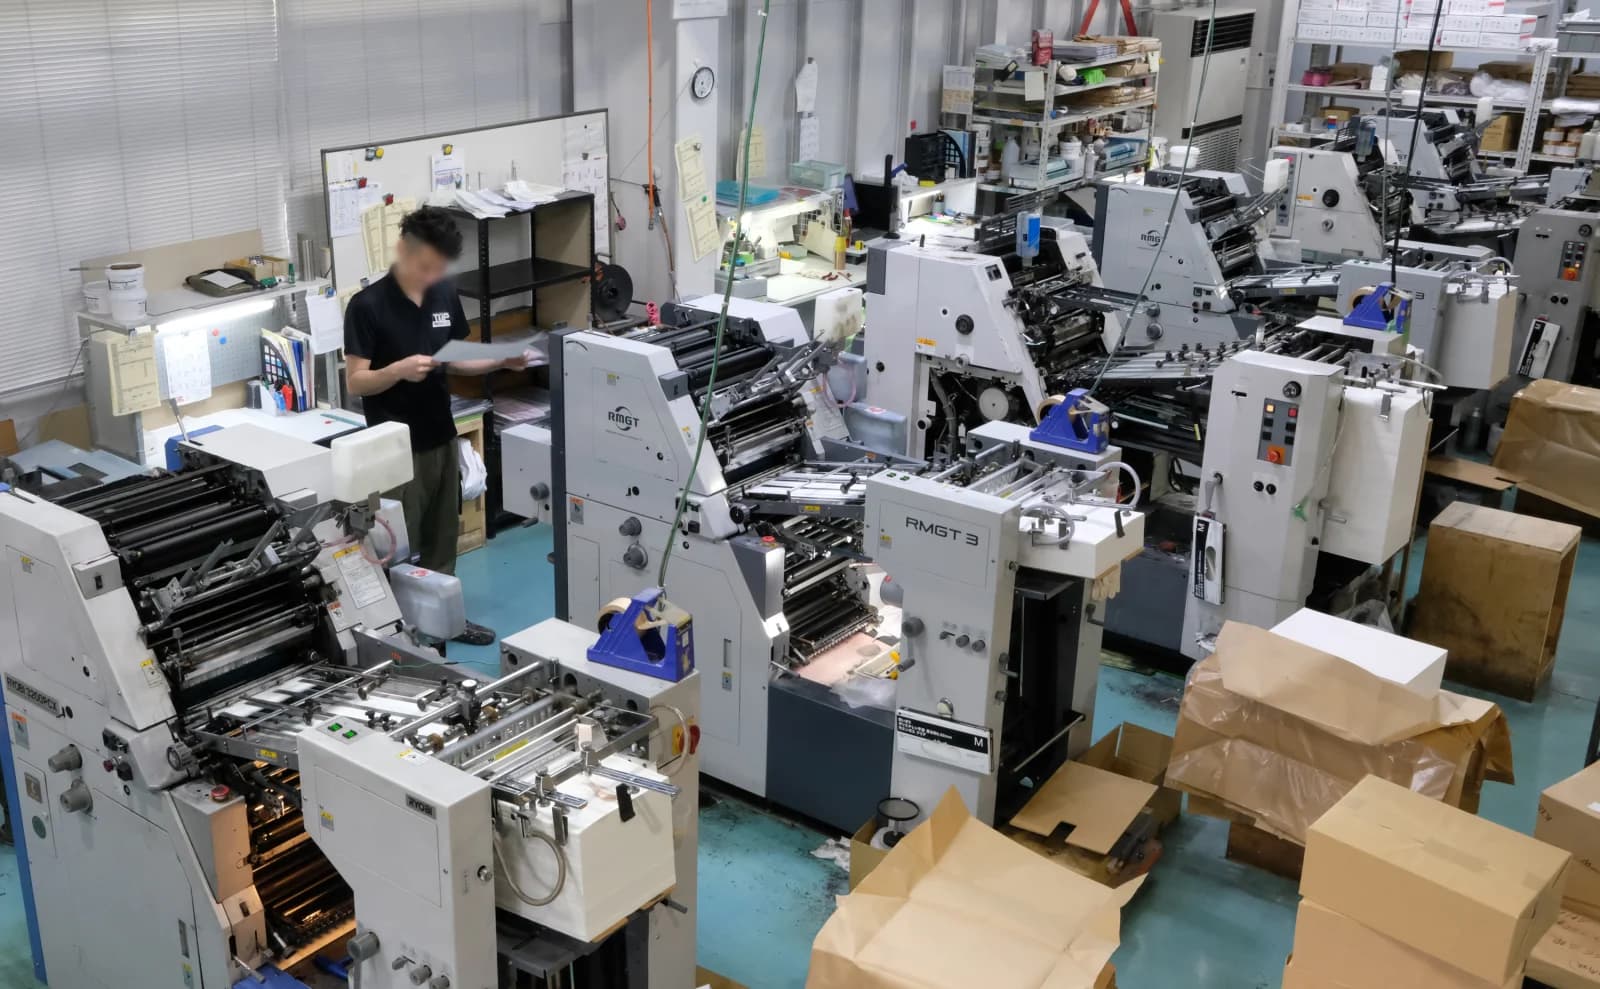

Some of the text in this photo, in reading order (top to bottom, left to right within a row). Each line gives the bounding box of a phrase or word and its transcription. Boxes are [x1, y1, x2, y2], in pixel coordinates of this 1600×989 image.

[1140, 233, 1162, 243] RMG
[608, 411, 640, 428] RMGT
[905, 516, 979, 546] RMGT 3
[1197, 523, 1205, 532] M
[974, 736, 984, 748] M
[407, 796, 433, 816] RYOBI
